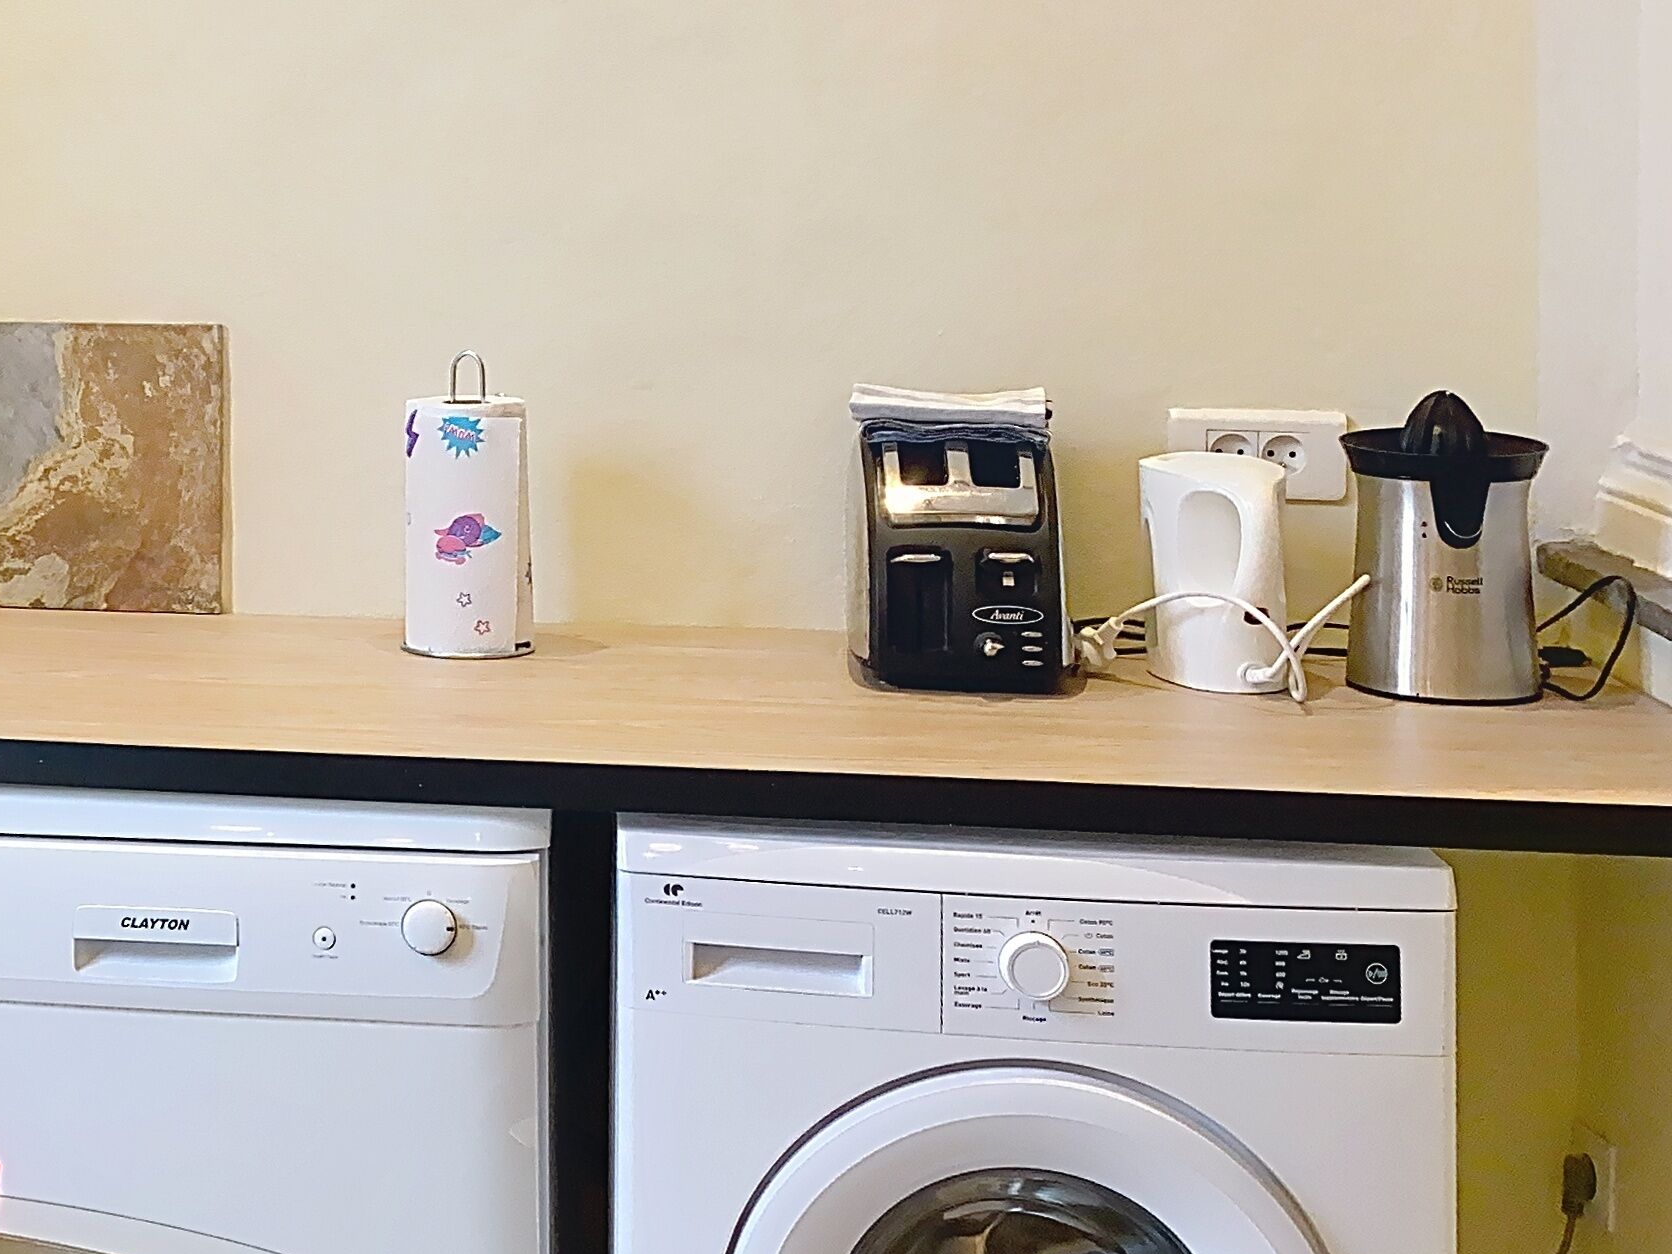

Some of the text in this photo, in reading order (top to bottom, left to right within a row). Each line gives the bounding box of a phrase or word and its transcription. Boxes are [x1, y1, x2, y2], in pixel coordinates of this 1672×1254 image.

[1447, 576, 1483, 586] Russell
[1447, 586, 1480, 594] Hobbs
[990, 609, 1025, 620] Avanti
[121, 916, 189, 930] CLAYTON
